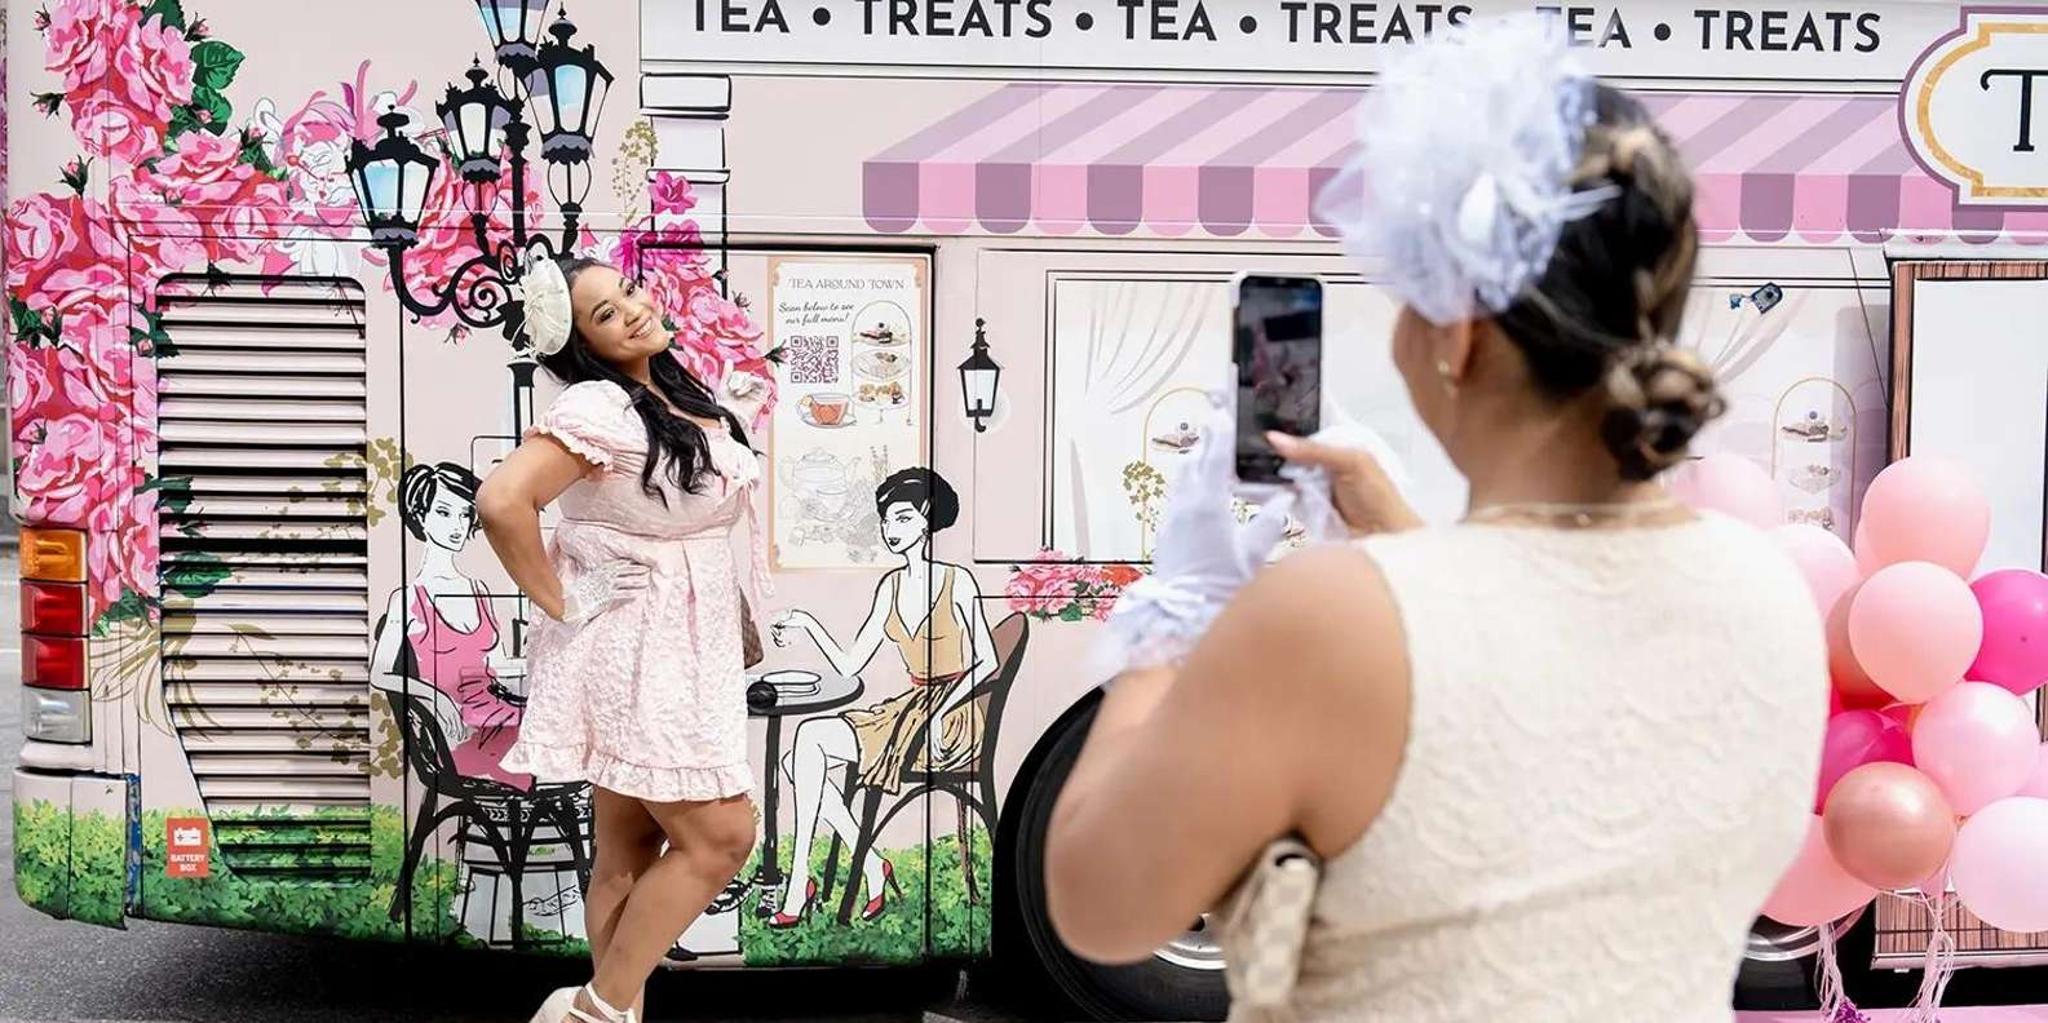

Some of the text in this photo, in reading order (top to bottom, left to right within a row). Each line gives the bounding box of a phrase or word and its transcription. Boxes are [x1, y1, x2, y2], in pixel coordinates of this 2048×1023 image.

[695, 0, 790, 33] TEA
[855, 0, 1052, 38] TREATS
[1117, 0, 1217, 41] TEA
[1694, 10, 1881, 53] TREATS
[790, 279, 905, 289] TEA AROUND TOWN
[778, 300, 855, 313] Scan below to see
[785, 312, 850, 327] our full menu!
[171, 854, 205, 862] BATTERY
[180, 863, 197, 872] BOX
